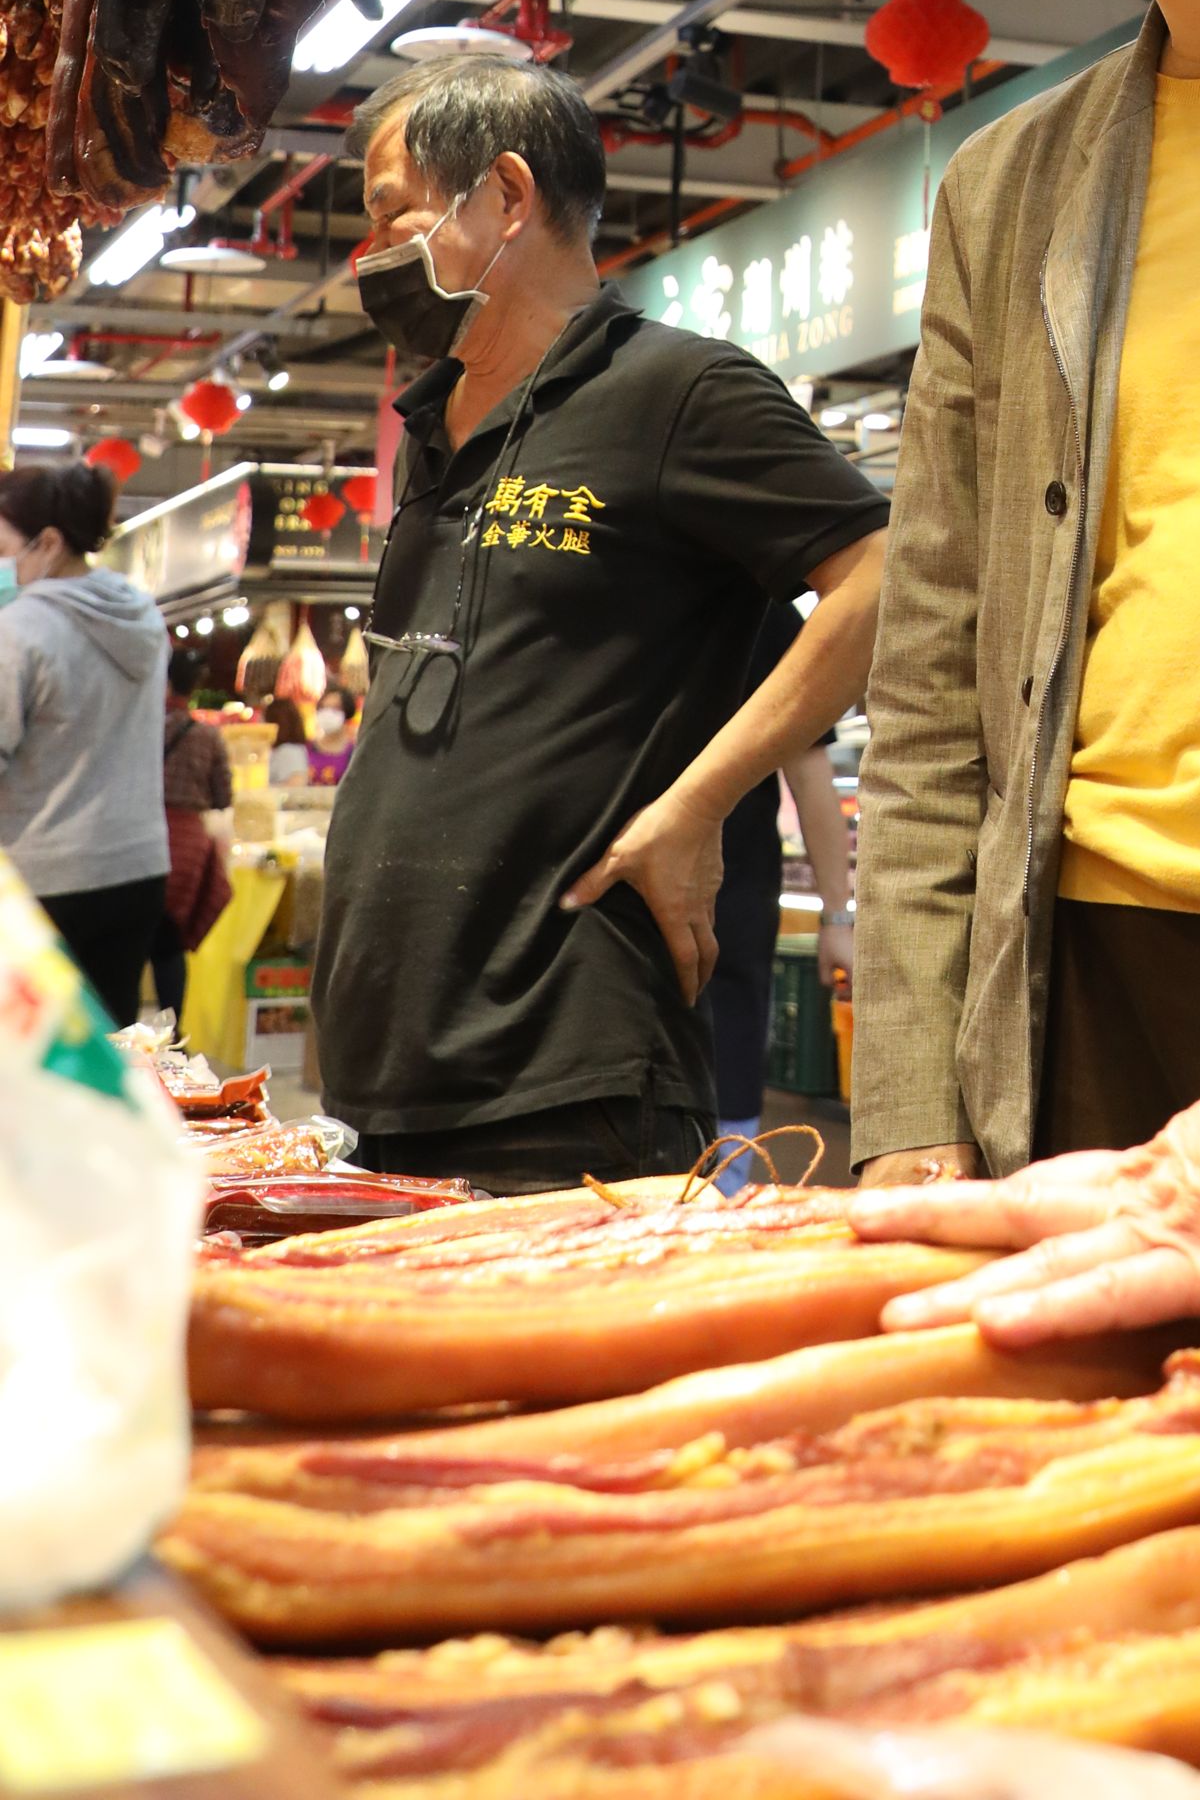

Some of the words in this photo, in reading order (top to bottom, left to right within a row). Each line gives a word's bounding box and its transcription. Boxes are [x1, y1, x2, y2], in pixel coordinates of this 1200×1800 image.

[485, 475, 606, 522] 萬有全
[480, 519, 591, 555] 金華火腿
